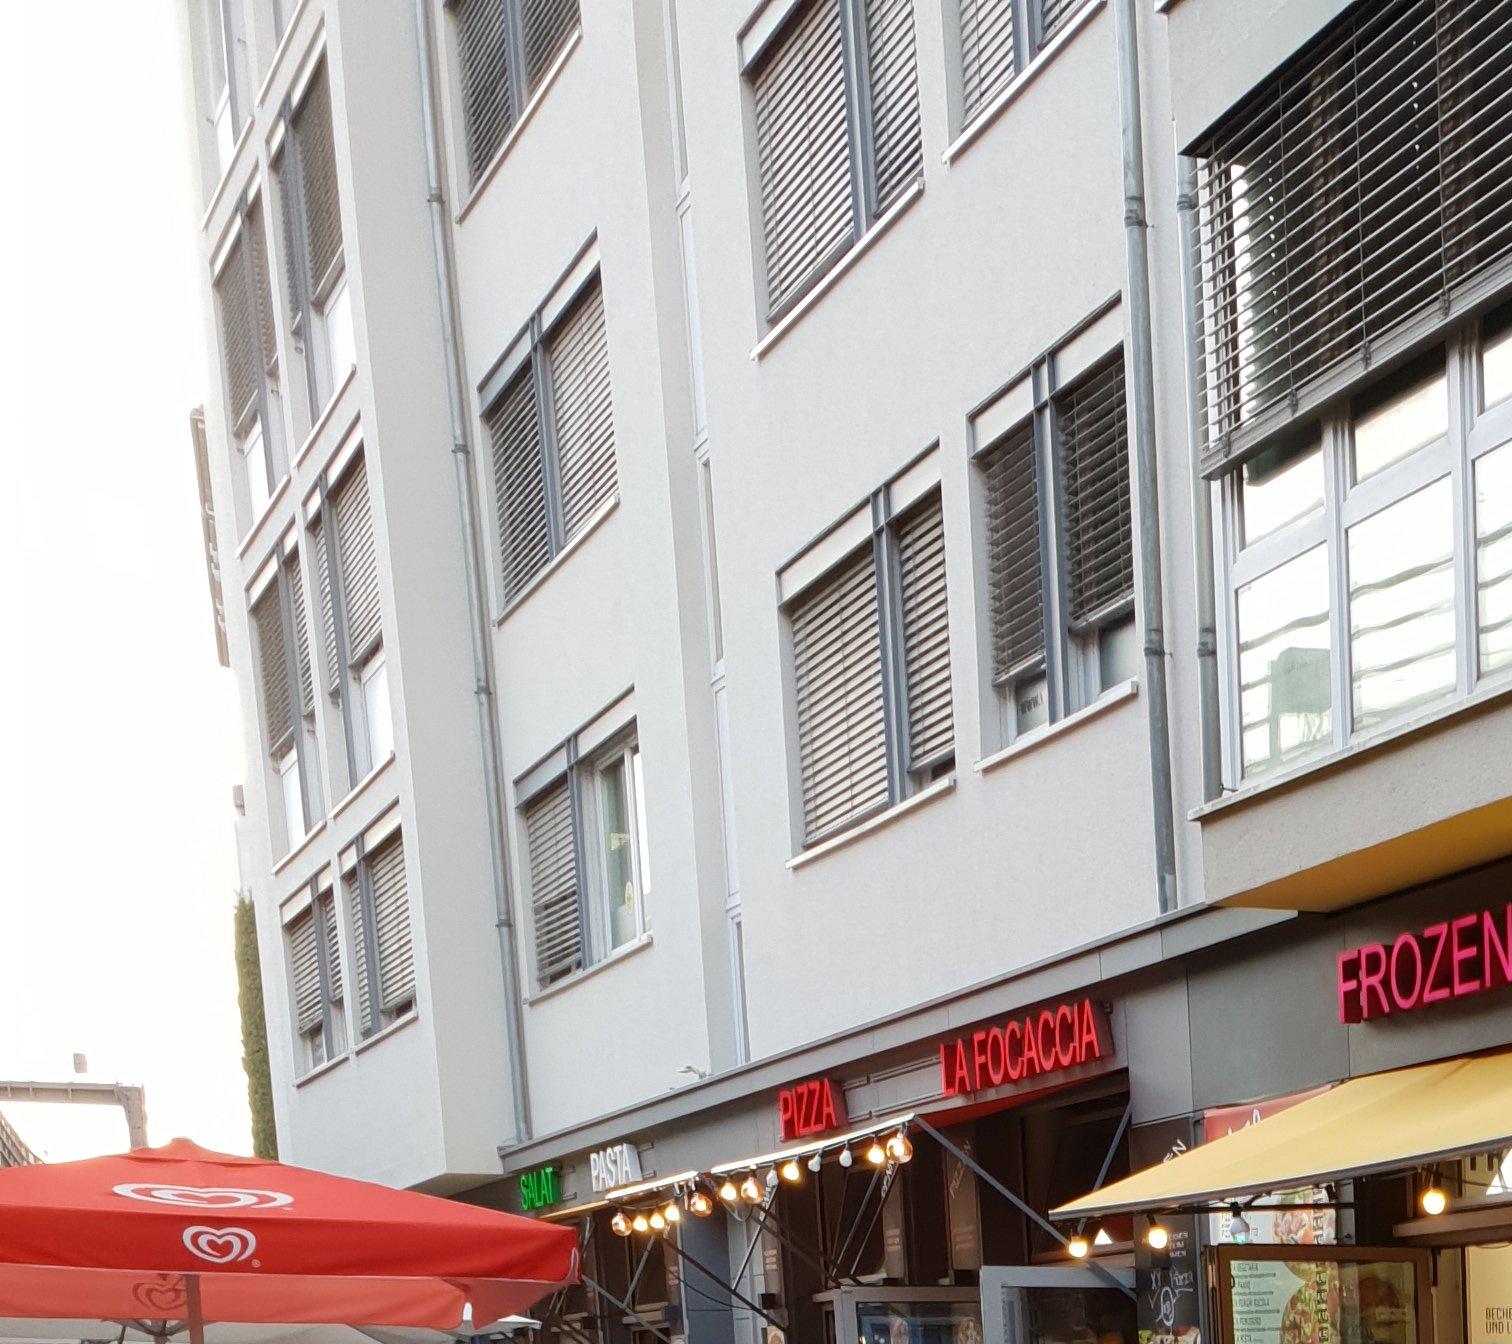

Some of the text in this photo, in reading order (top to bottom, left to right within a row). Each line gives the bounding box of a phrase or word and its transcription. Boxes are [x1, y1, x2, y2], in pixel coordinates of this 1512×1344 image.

[939, 998, 1100, 1098] LA FOCACCIA
[779, 1078, 837, 1141] PIZZA
[520, 1166, 554, 1210] SALAT
[590, 1142, 633, 1192] PASTA
[1485, 1321, 1504, 1334] UND
